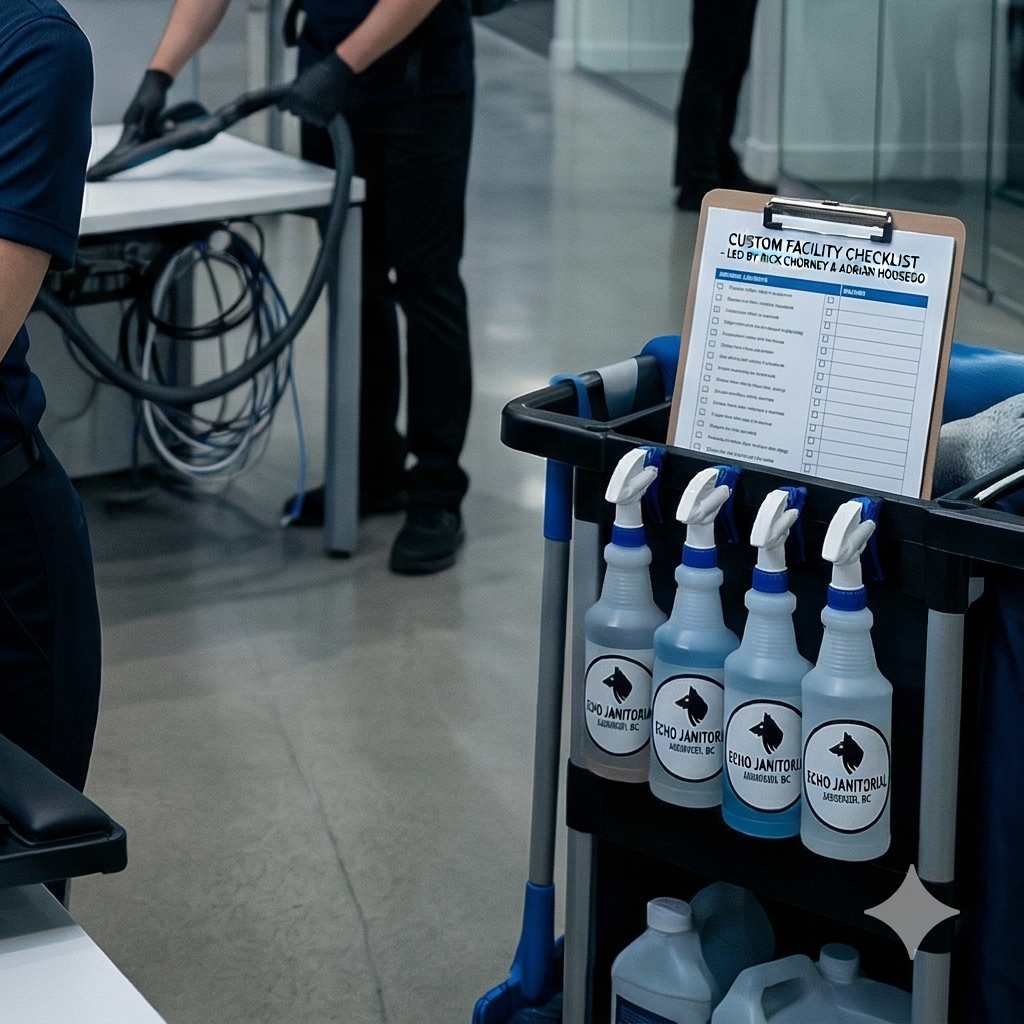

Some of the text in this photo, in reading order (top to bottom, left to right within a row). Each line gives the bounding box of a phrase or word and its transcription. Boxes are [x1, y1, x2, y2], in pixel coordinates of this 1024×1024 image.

[726, 247, 745, 260] LED
[783, 255, 829, 271] CHORNEY
[838, 262, 876, 277] ADRIAN
[728, 232, 921, 270] CUSTOM FACILITY CHECKLIST
